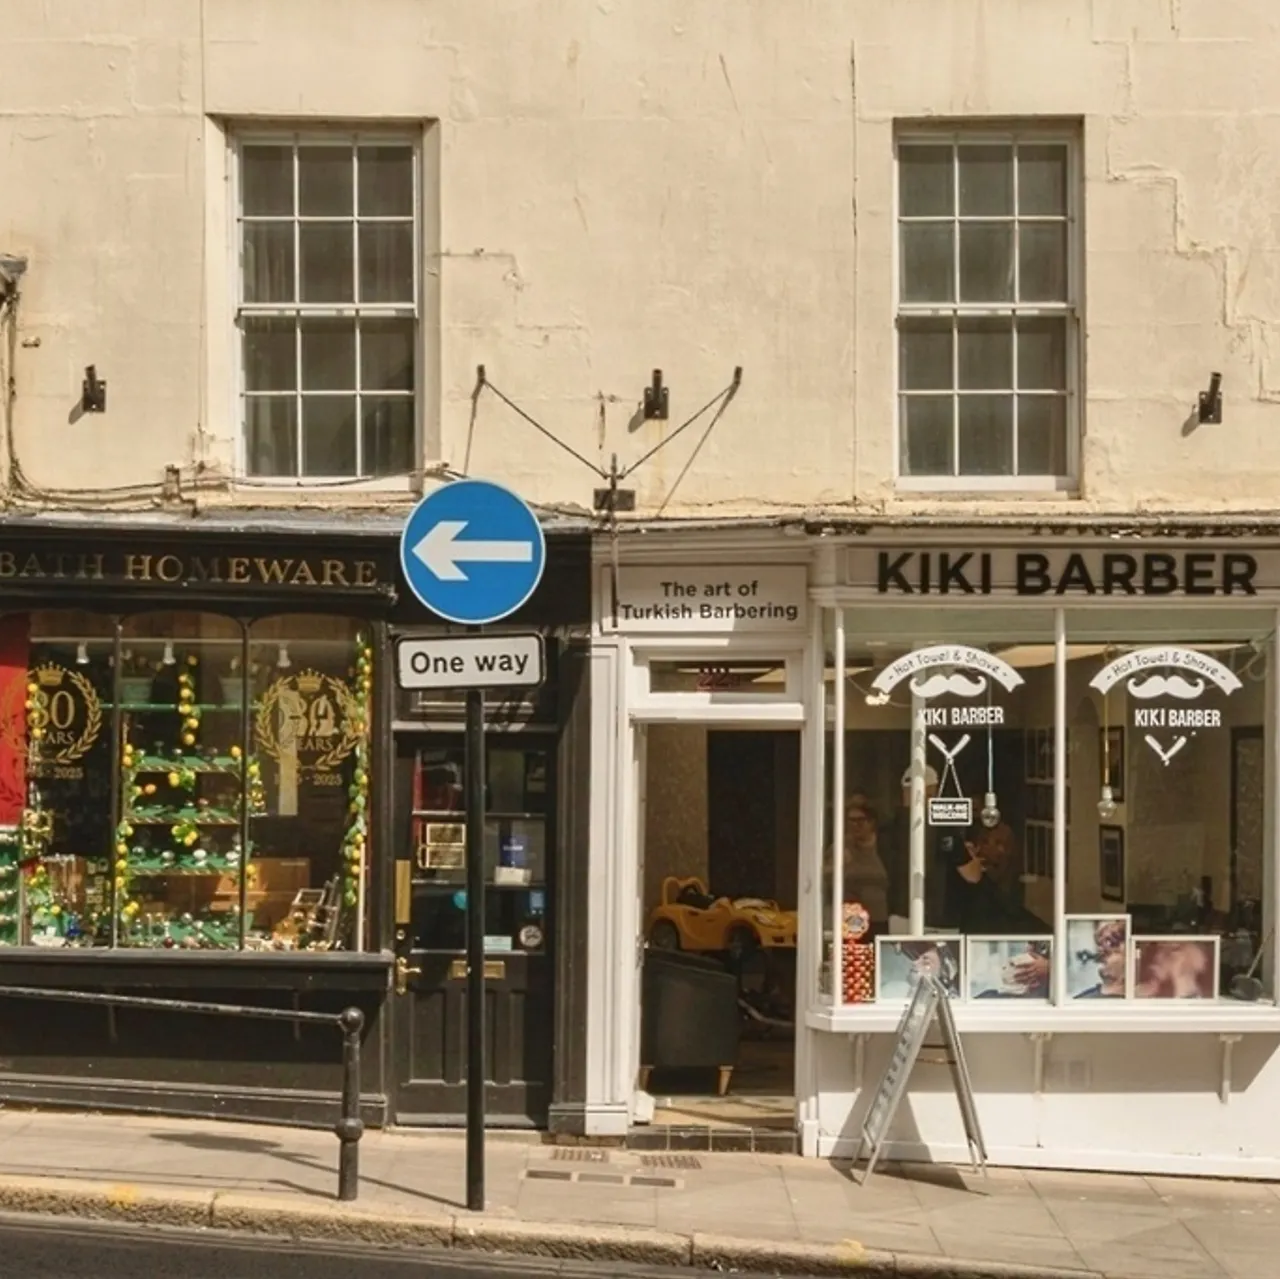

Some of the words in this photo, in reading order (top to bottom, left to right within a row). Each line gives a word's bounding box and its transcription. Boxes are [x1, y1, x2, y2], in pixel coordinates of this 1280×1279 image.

[124, 554, 379, 588] HOMEWARE
[877, 552, 992, 595] KIKI
[1015, 552, 1258, 596] BARBER
[660, 581, 697, 597] The
[703, 582, 731, 597] art
[737, 580, 759, 597] of
[621, 603, 692, 619] Turkish
[699, 603, 798, 621] Barbering
[410, 651, 465, 675] One
[474, 653, 529, 675] way
[916, 651, 951, 666] Towel
[965, 651, 1001, 673] Shave
[1135, 651, 1169, 665] Towel
[1183, 653, 1219, 676] Shave
[918, 707, 948, 726] KIKI
[951, 706, 1005, 725] BARBER
[1134, 708, 1166, 727] KIKI
[1168, 709, 1221, 727] BARBER
